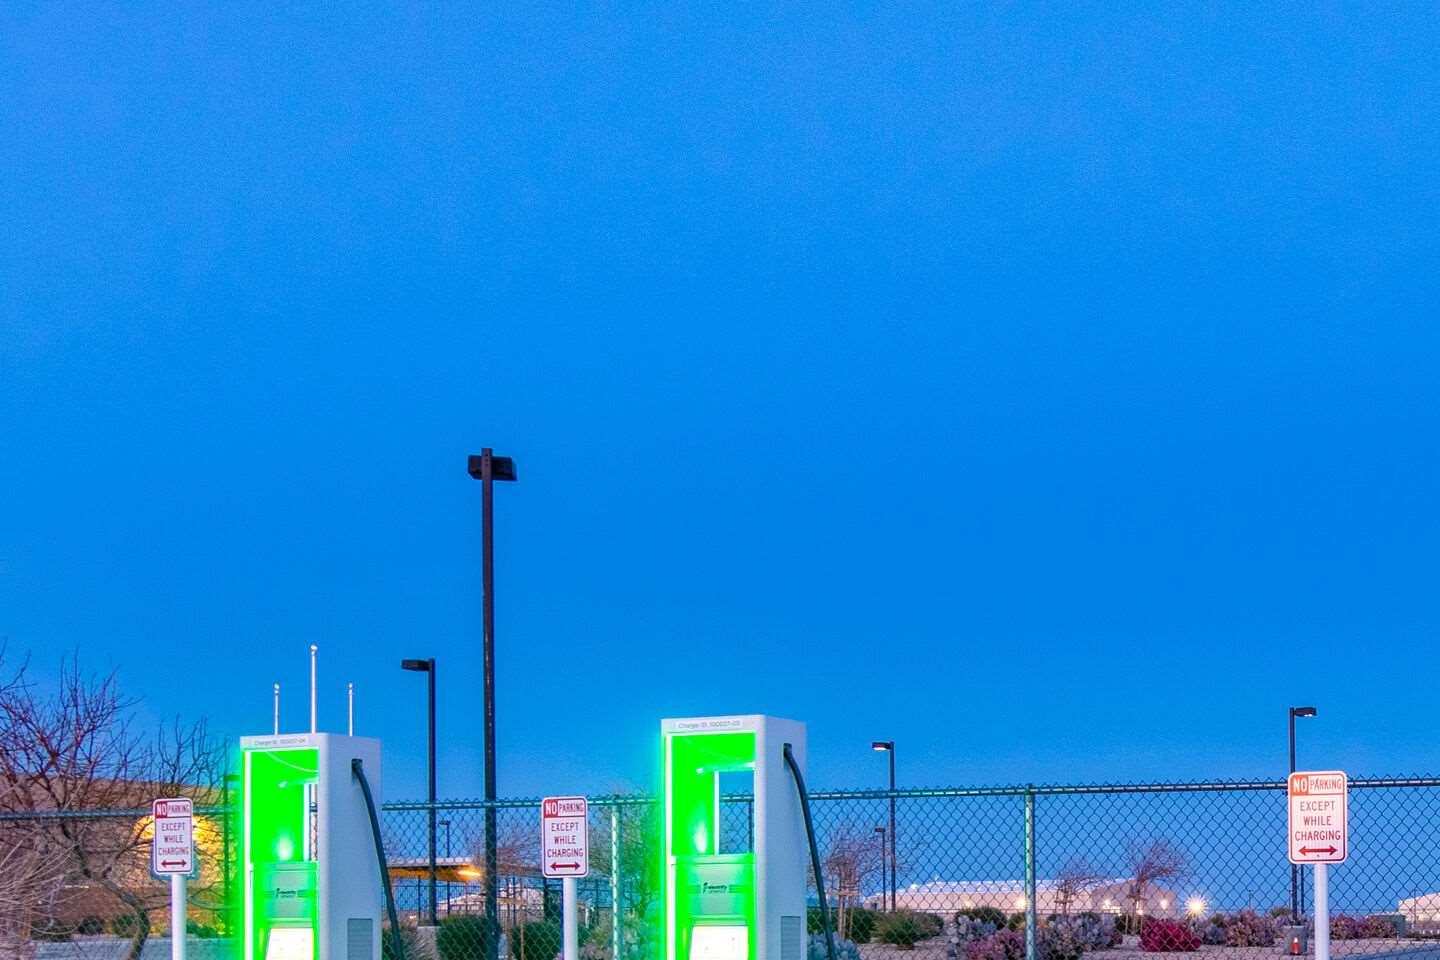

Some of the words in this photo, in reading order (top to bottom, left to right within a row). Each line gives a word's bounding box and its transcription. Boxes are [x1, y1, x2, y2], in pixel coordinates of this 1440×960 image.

[1294, 777, 1308, 793] NO
[1310, 778, 1342, 790] PARKING
[156, 802, 167, 816] NO
[545, 802, 557, 816] NO
[559, 803, 584, 813] PARKING
[1300, 801, 1336, 812] EXCEPT
[1303, 816, 1332, 826] WHILE
[161, 823, 185, 831] EXCEPT
[551, 822, 579, 832] EXCEPT
[163, 834, 184, 843] WHILE
[553, 836, 577, 845] WHILE
[1294, 830, 1341, 842] CHARGING
[158, 847, 189, 856] CHARGING
[547, 848, 584, 858] CHARGING
